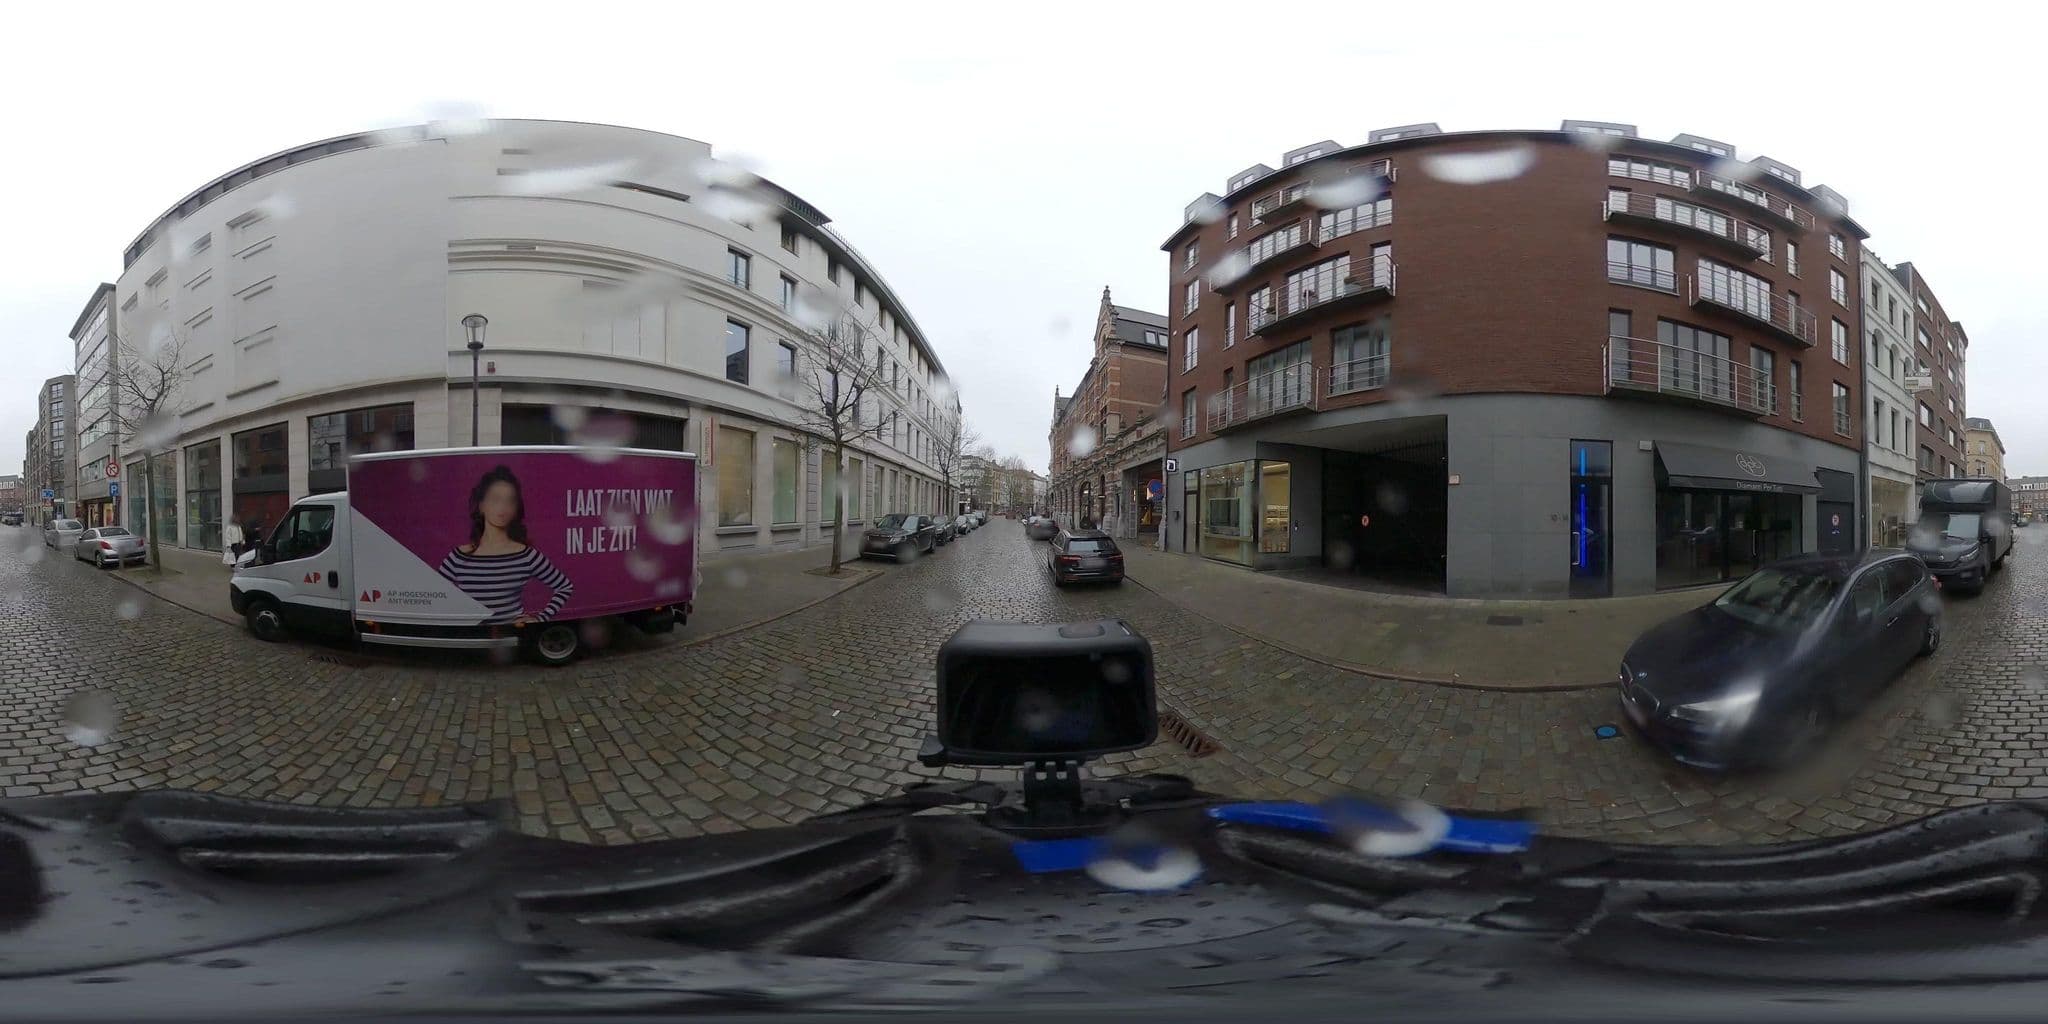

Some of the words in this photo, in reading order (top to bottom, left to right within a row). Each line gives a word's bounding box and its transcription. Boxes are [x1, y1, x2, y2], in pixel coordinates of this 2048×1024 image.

[111, 485, 118, 494] P
[566, 489, 604, 517] LAAT
[607, 488, 641, 515] ZIEN
[644, 489, 673, 515] WAT
[566, 527, 584, 555] IN
[587, 526, 606, 554] JE
[609, 525, 637, 552] ZIT!
[303, 572, 321, 584] AP
[360, 590, 382, 602] AP
[388, 597, 432, 606] ANTWERPEN
[400, 591, 447, 600] HOGESCHOOL
